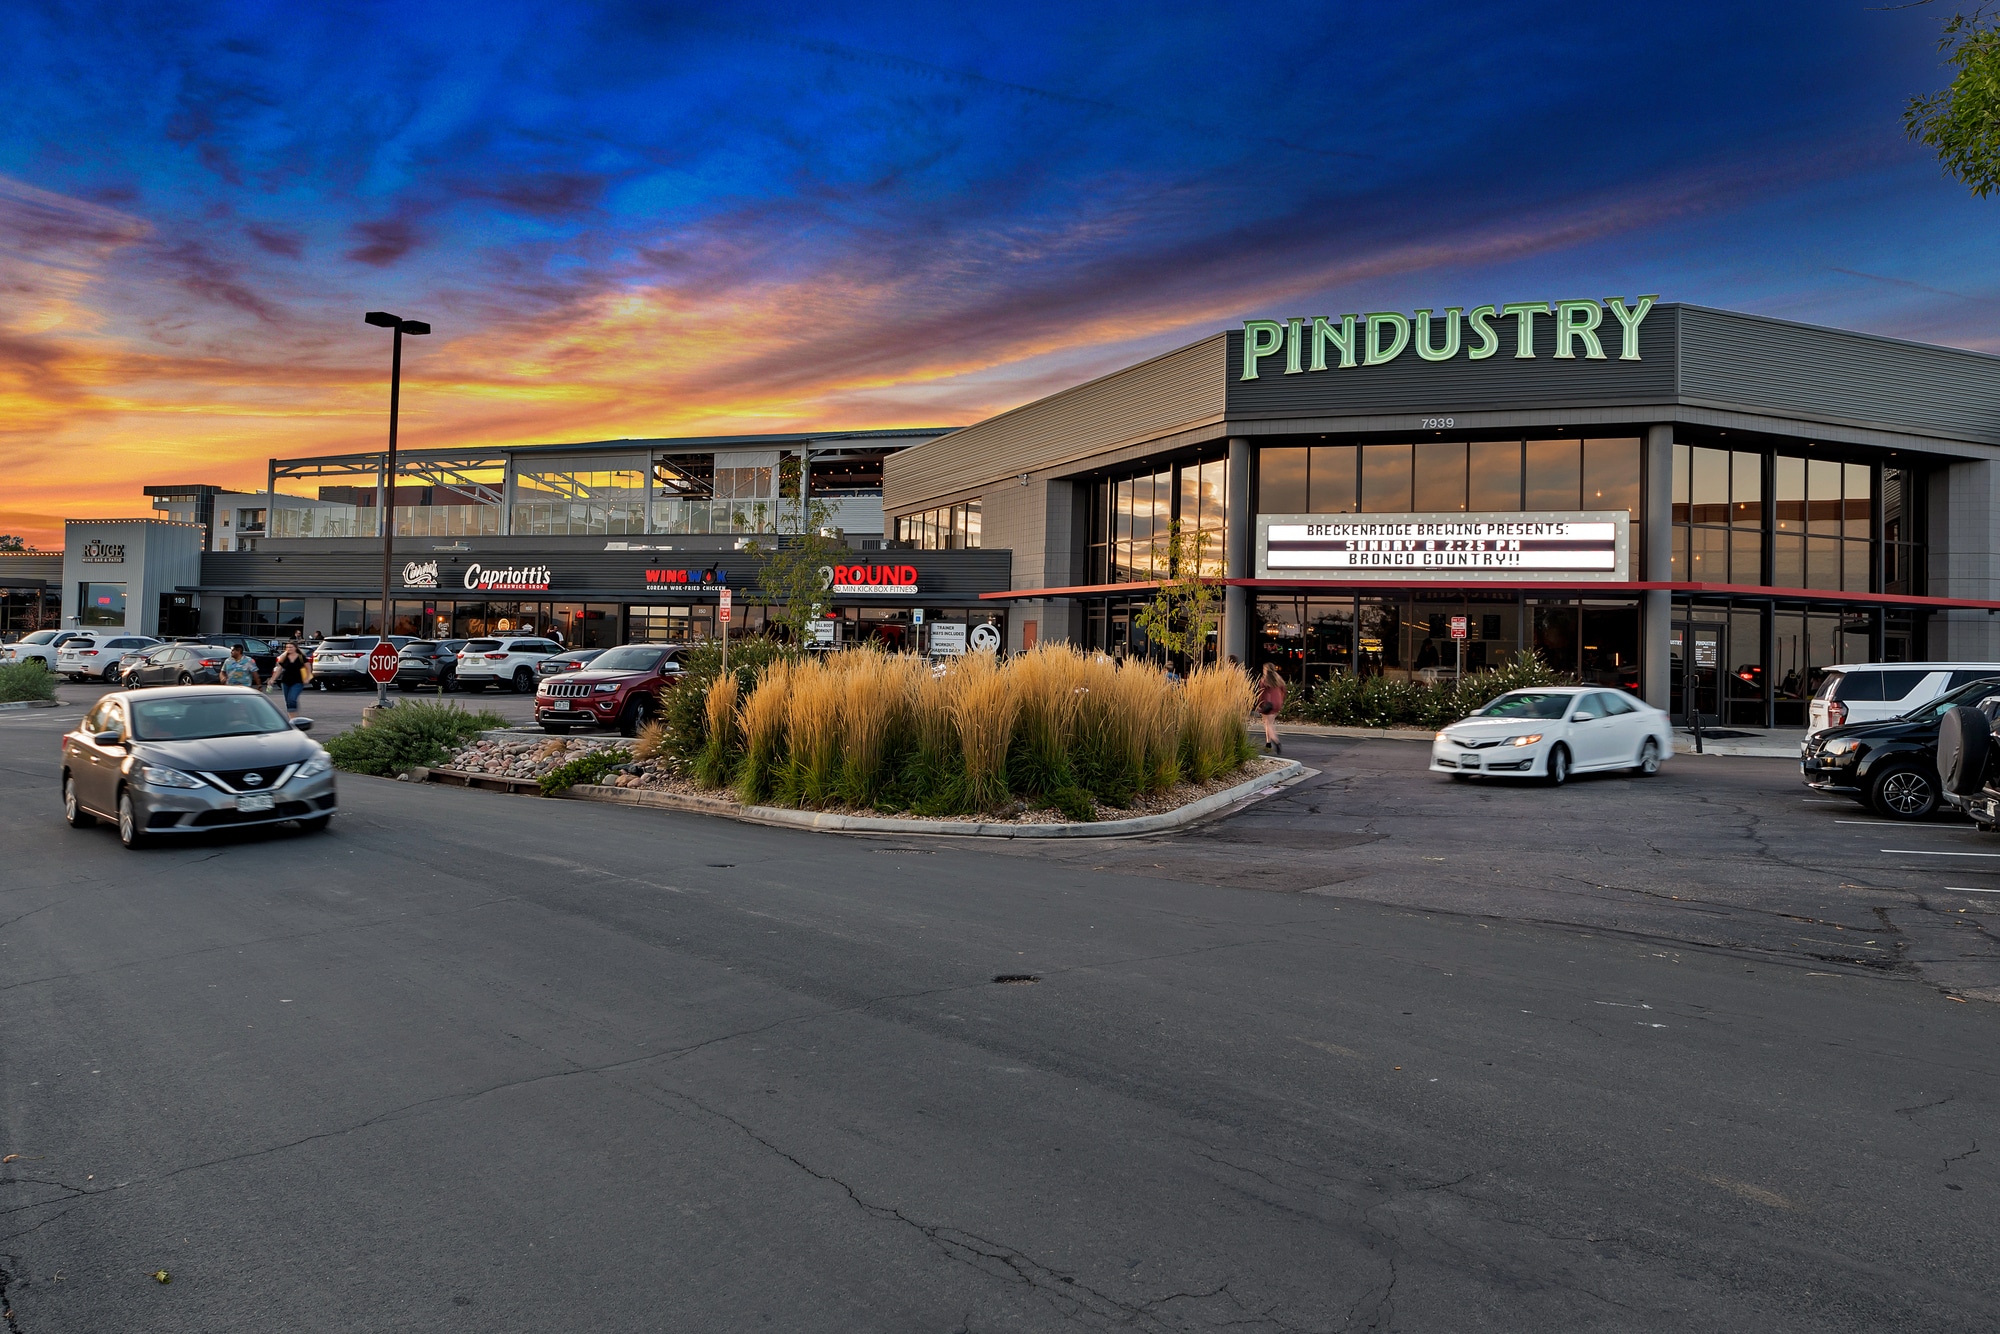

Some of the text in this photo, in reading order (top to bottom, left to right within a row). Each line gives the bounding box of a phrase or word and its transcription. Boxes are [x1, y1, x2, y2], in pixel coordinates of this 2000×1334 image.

[1239, 294, 1660, 381] PINDUSTRY
[1421, 417, 1455, 429] 7939
[1307, 524, 1569, 536] BRECKENRIDGE BREWING PRESENTS:
[83, 544, 124, 557] ROUGE
[1345, 540, 1521, 551] SUNDAY @ 2:25 PM
[1349, 553, 1520, 565] BRONCO COUNTRY!!
[464, 563, 551, 590] Capriotti's
[371, 655, 397, 670] STOP
